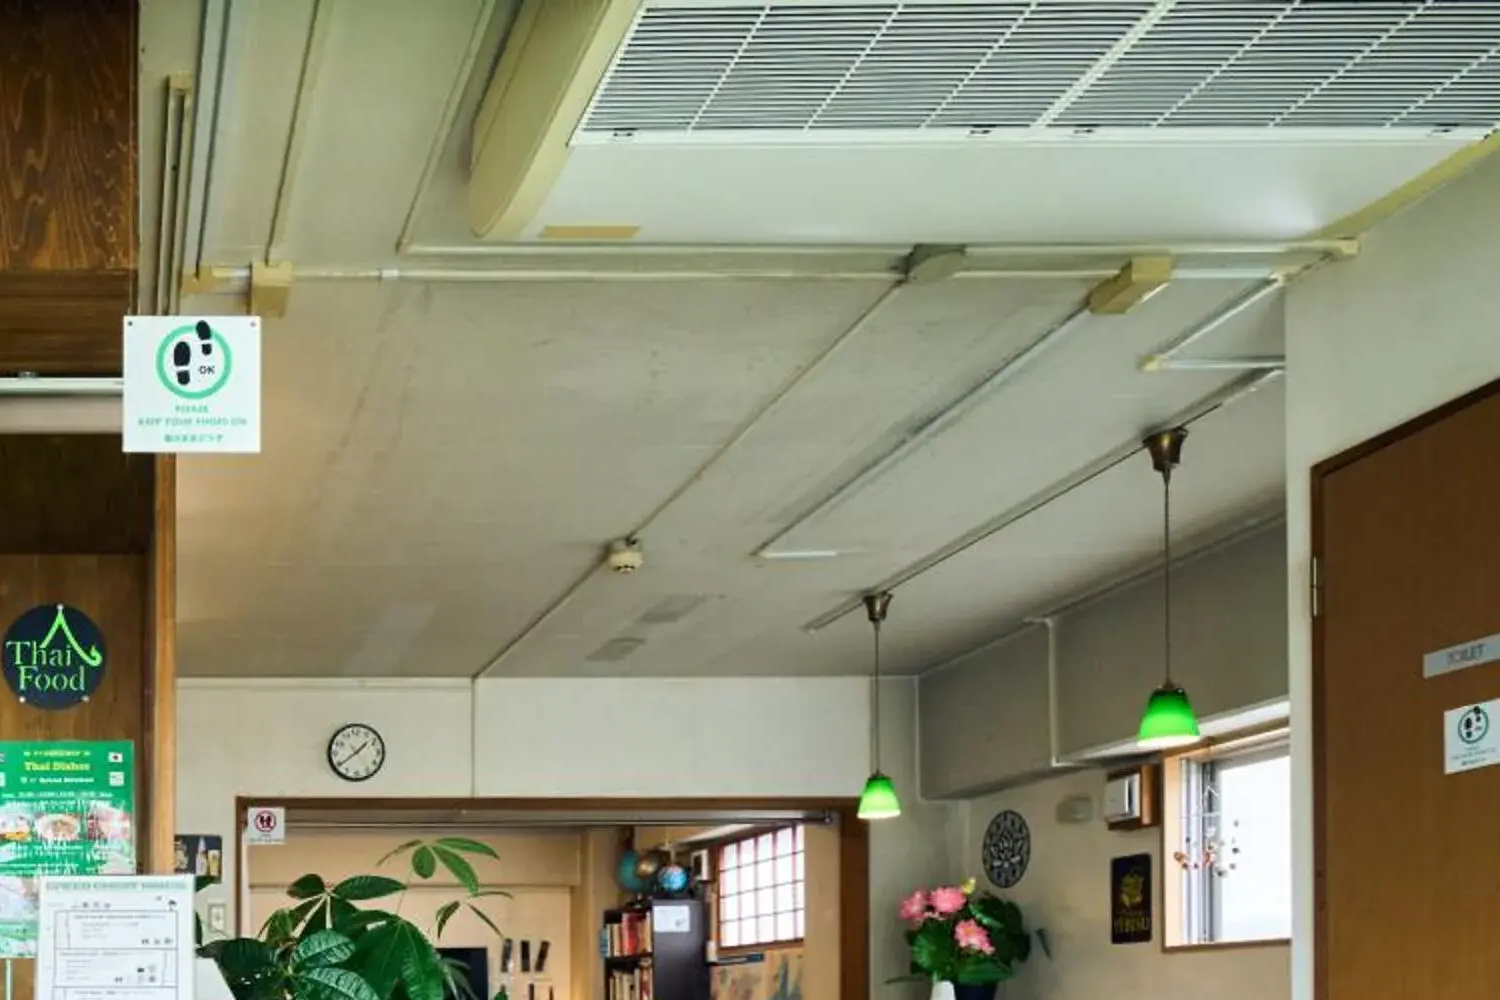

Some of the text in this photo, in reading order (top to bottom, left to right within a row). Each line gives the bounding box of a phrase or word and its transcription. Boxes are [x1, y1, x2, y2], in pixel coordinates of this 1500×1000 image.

[198, 365, 216, 375] OK
[5, 640, 73, 668] Thai
[18, 664, 86, 693] Food
